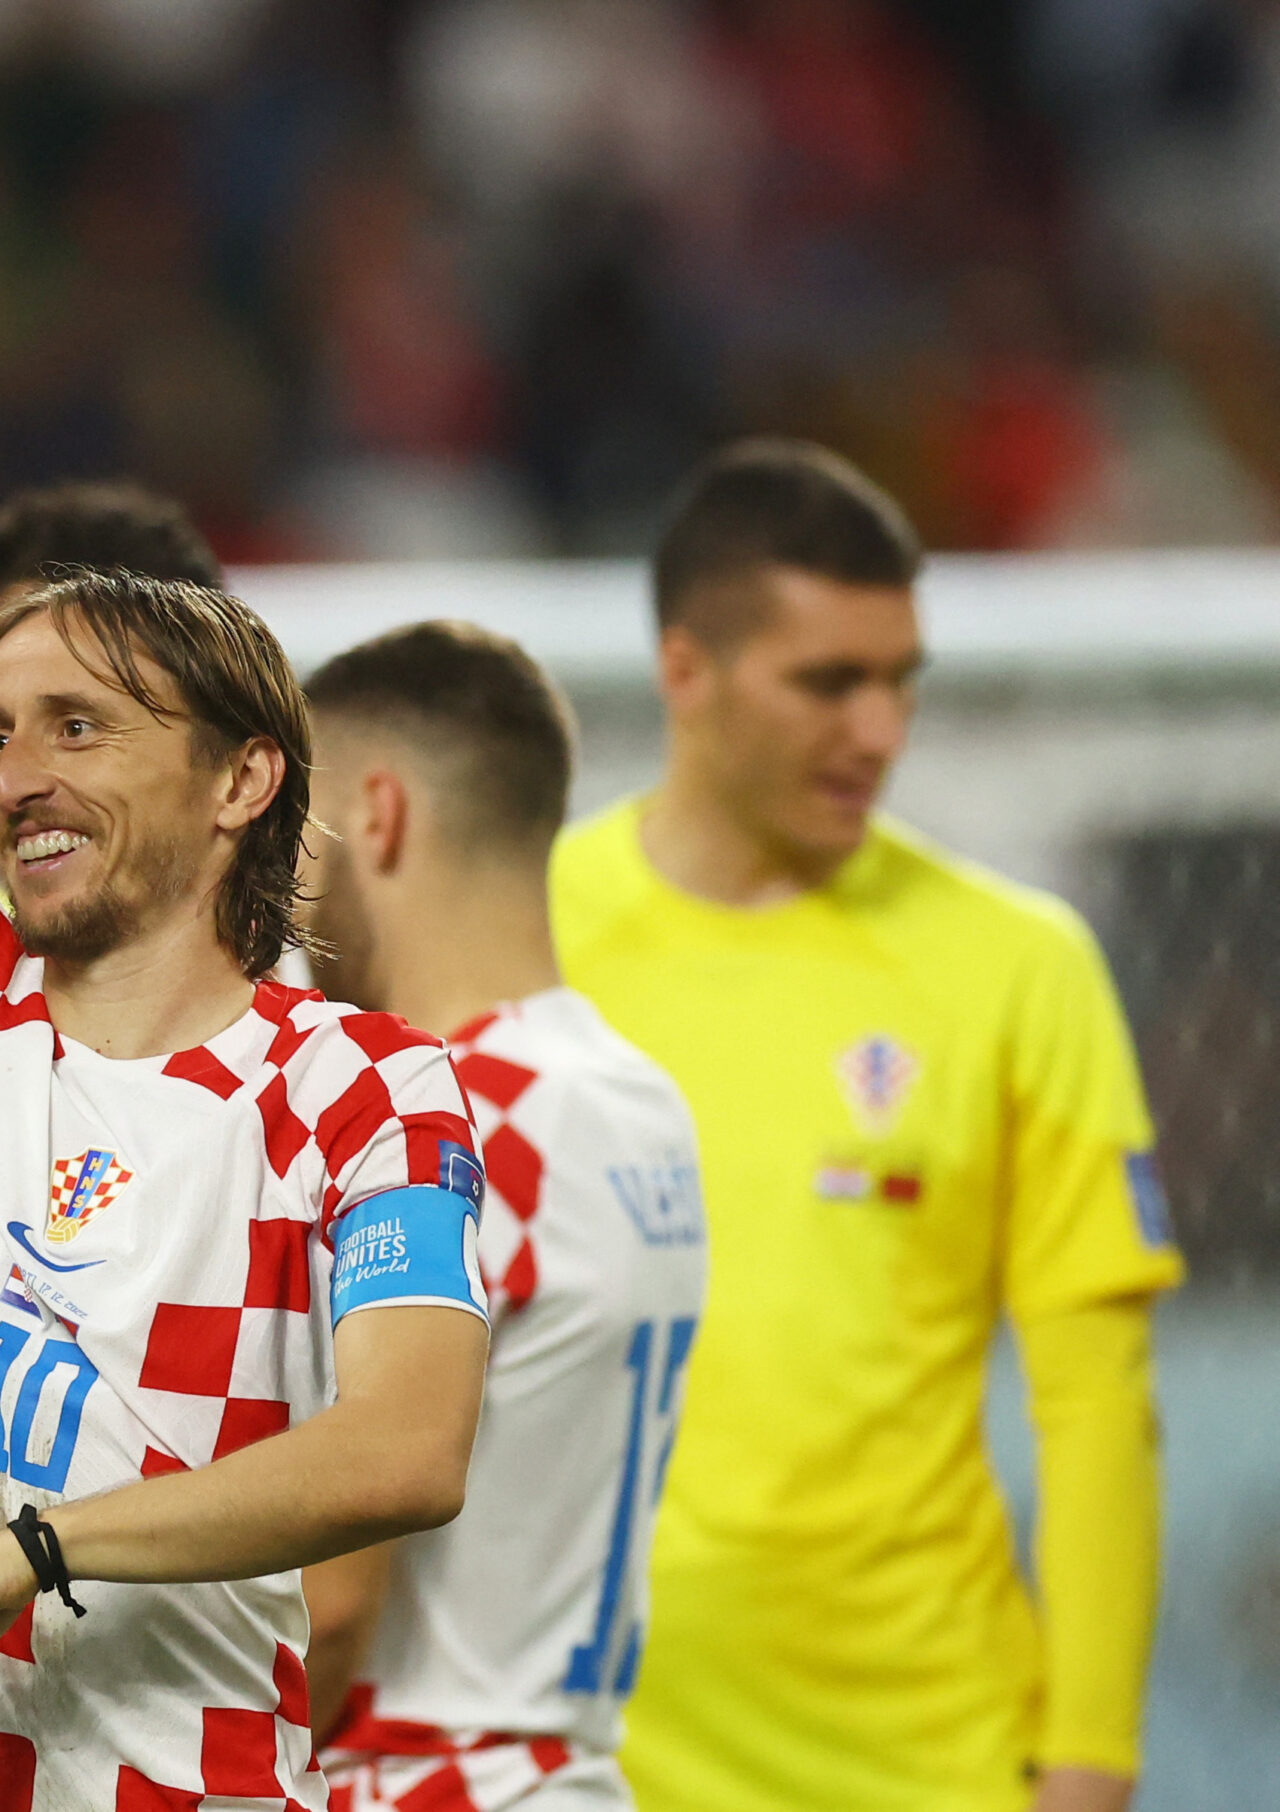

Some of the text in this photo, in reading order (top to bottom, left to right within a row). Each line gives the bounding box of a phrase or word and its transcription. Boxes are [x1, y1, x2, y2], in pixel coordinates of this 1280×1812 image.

[72, 1157, 104, 1208] HNS
[336, 1234, 407, 1279] UNITES
[339, 1216, 404, 1257] FOOTBALL
[355, 1258, 410, 1282] World
